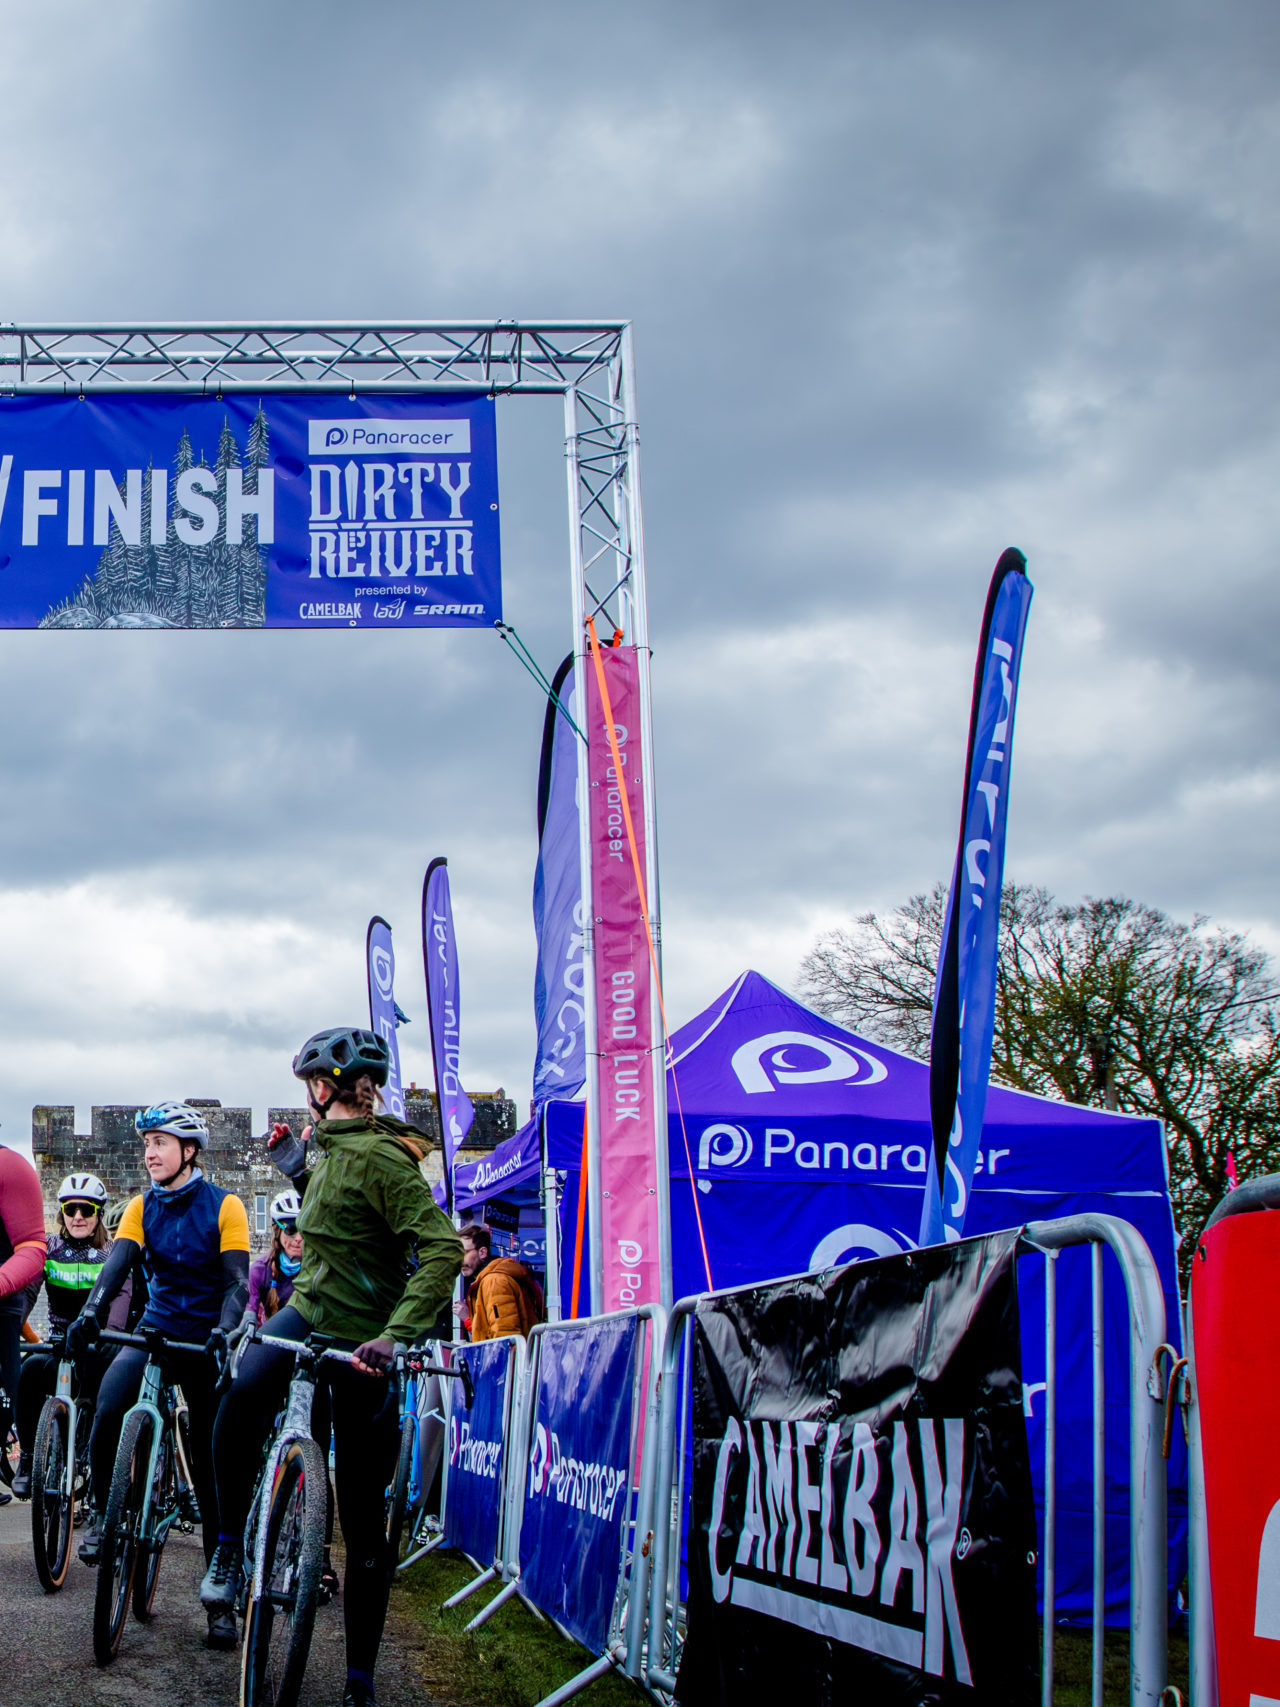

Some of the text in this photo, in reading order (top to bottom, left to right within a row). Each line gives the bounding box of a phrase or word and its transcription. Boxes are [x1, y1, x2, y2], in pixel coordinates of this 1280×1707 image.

[353, 428, 454, 445] Panaracer
[308, 460, 471, 521] DIRTY
[308, 529, 474, 578] REIVER
[300, 602, 362, 619] CAMELBAK
[413, 603, 484, 616] SRAM
[355, 585, 428, 597] presented by
[611, 970, 640, 1122] GOOD LUCK
[764, 1128, 1010, 1174] Panarar
[458, 1421, 501, 1479] Panaracer
[546, 1432, 626, 1522] Panaracer
